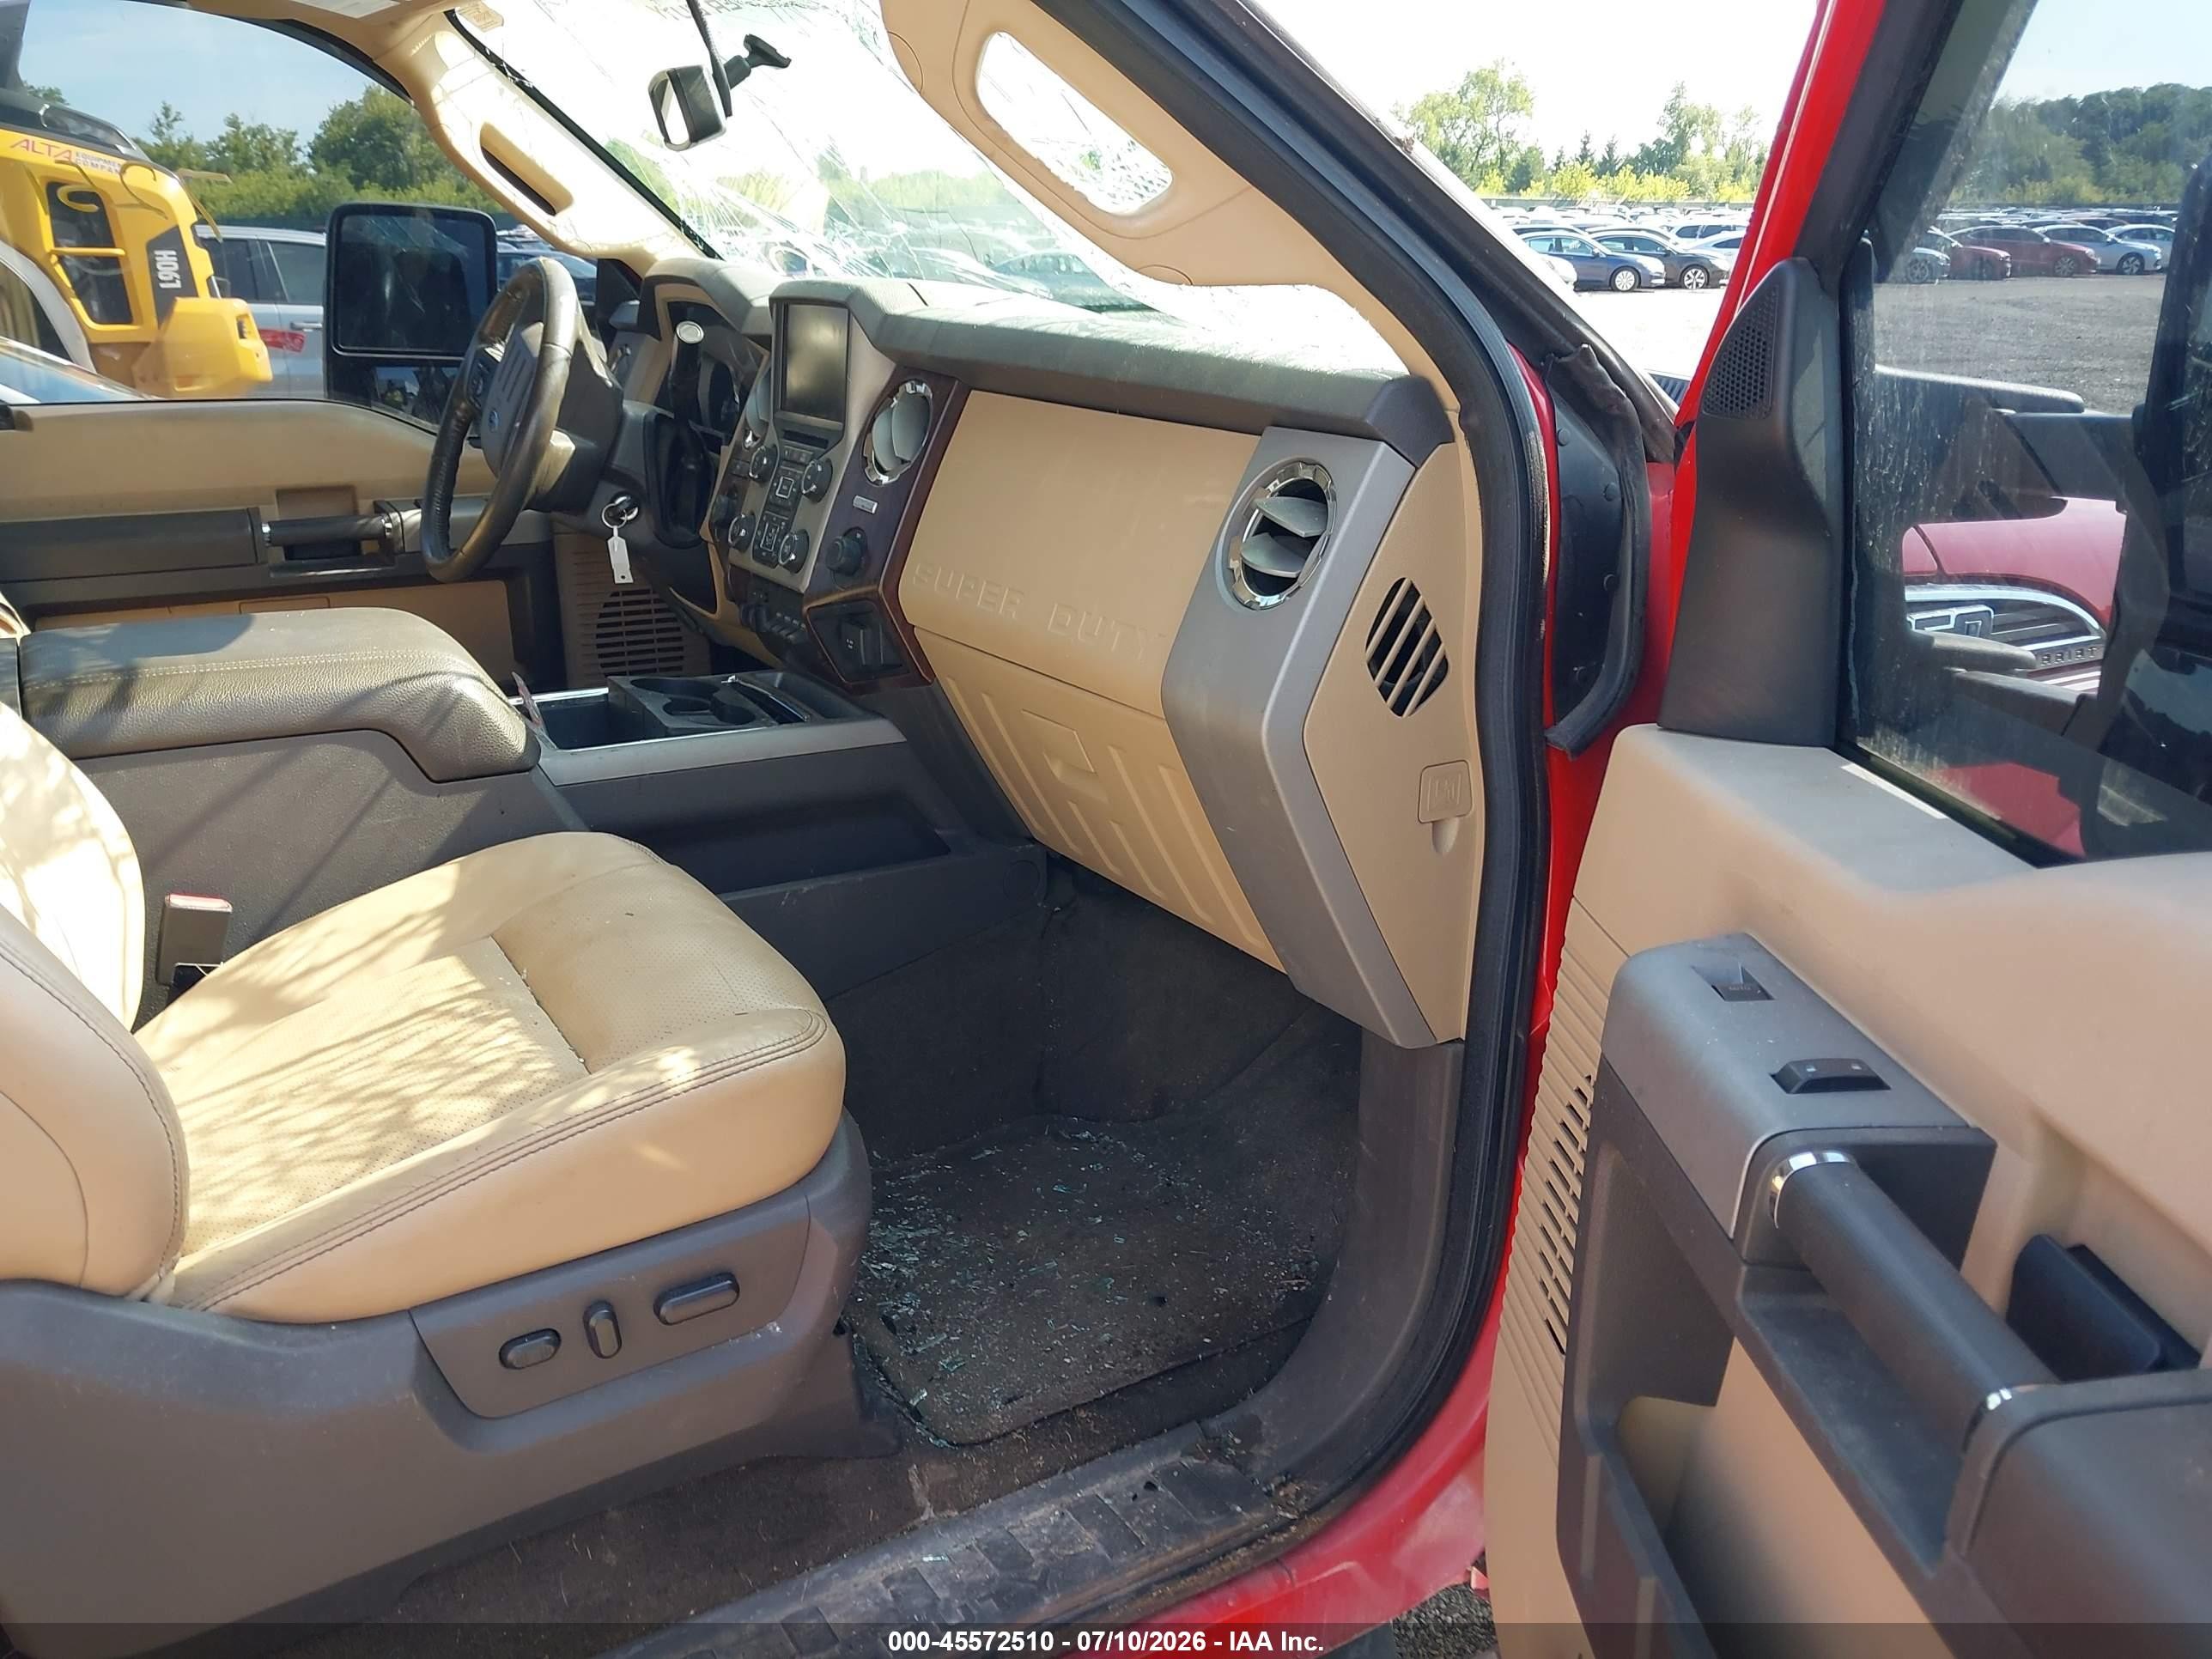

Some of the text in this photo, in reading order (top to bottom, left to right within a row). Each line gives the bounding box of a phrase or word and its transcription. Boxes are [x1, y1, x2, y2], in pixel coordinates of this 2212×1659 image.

[9, 138, 72, 162] ALTA
[154, 250, 182, 289] L90H
[913, 562, 1166, 660] SUPER DUTY
